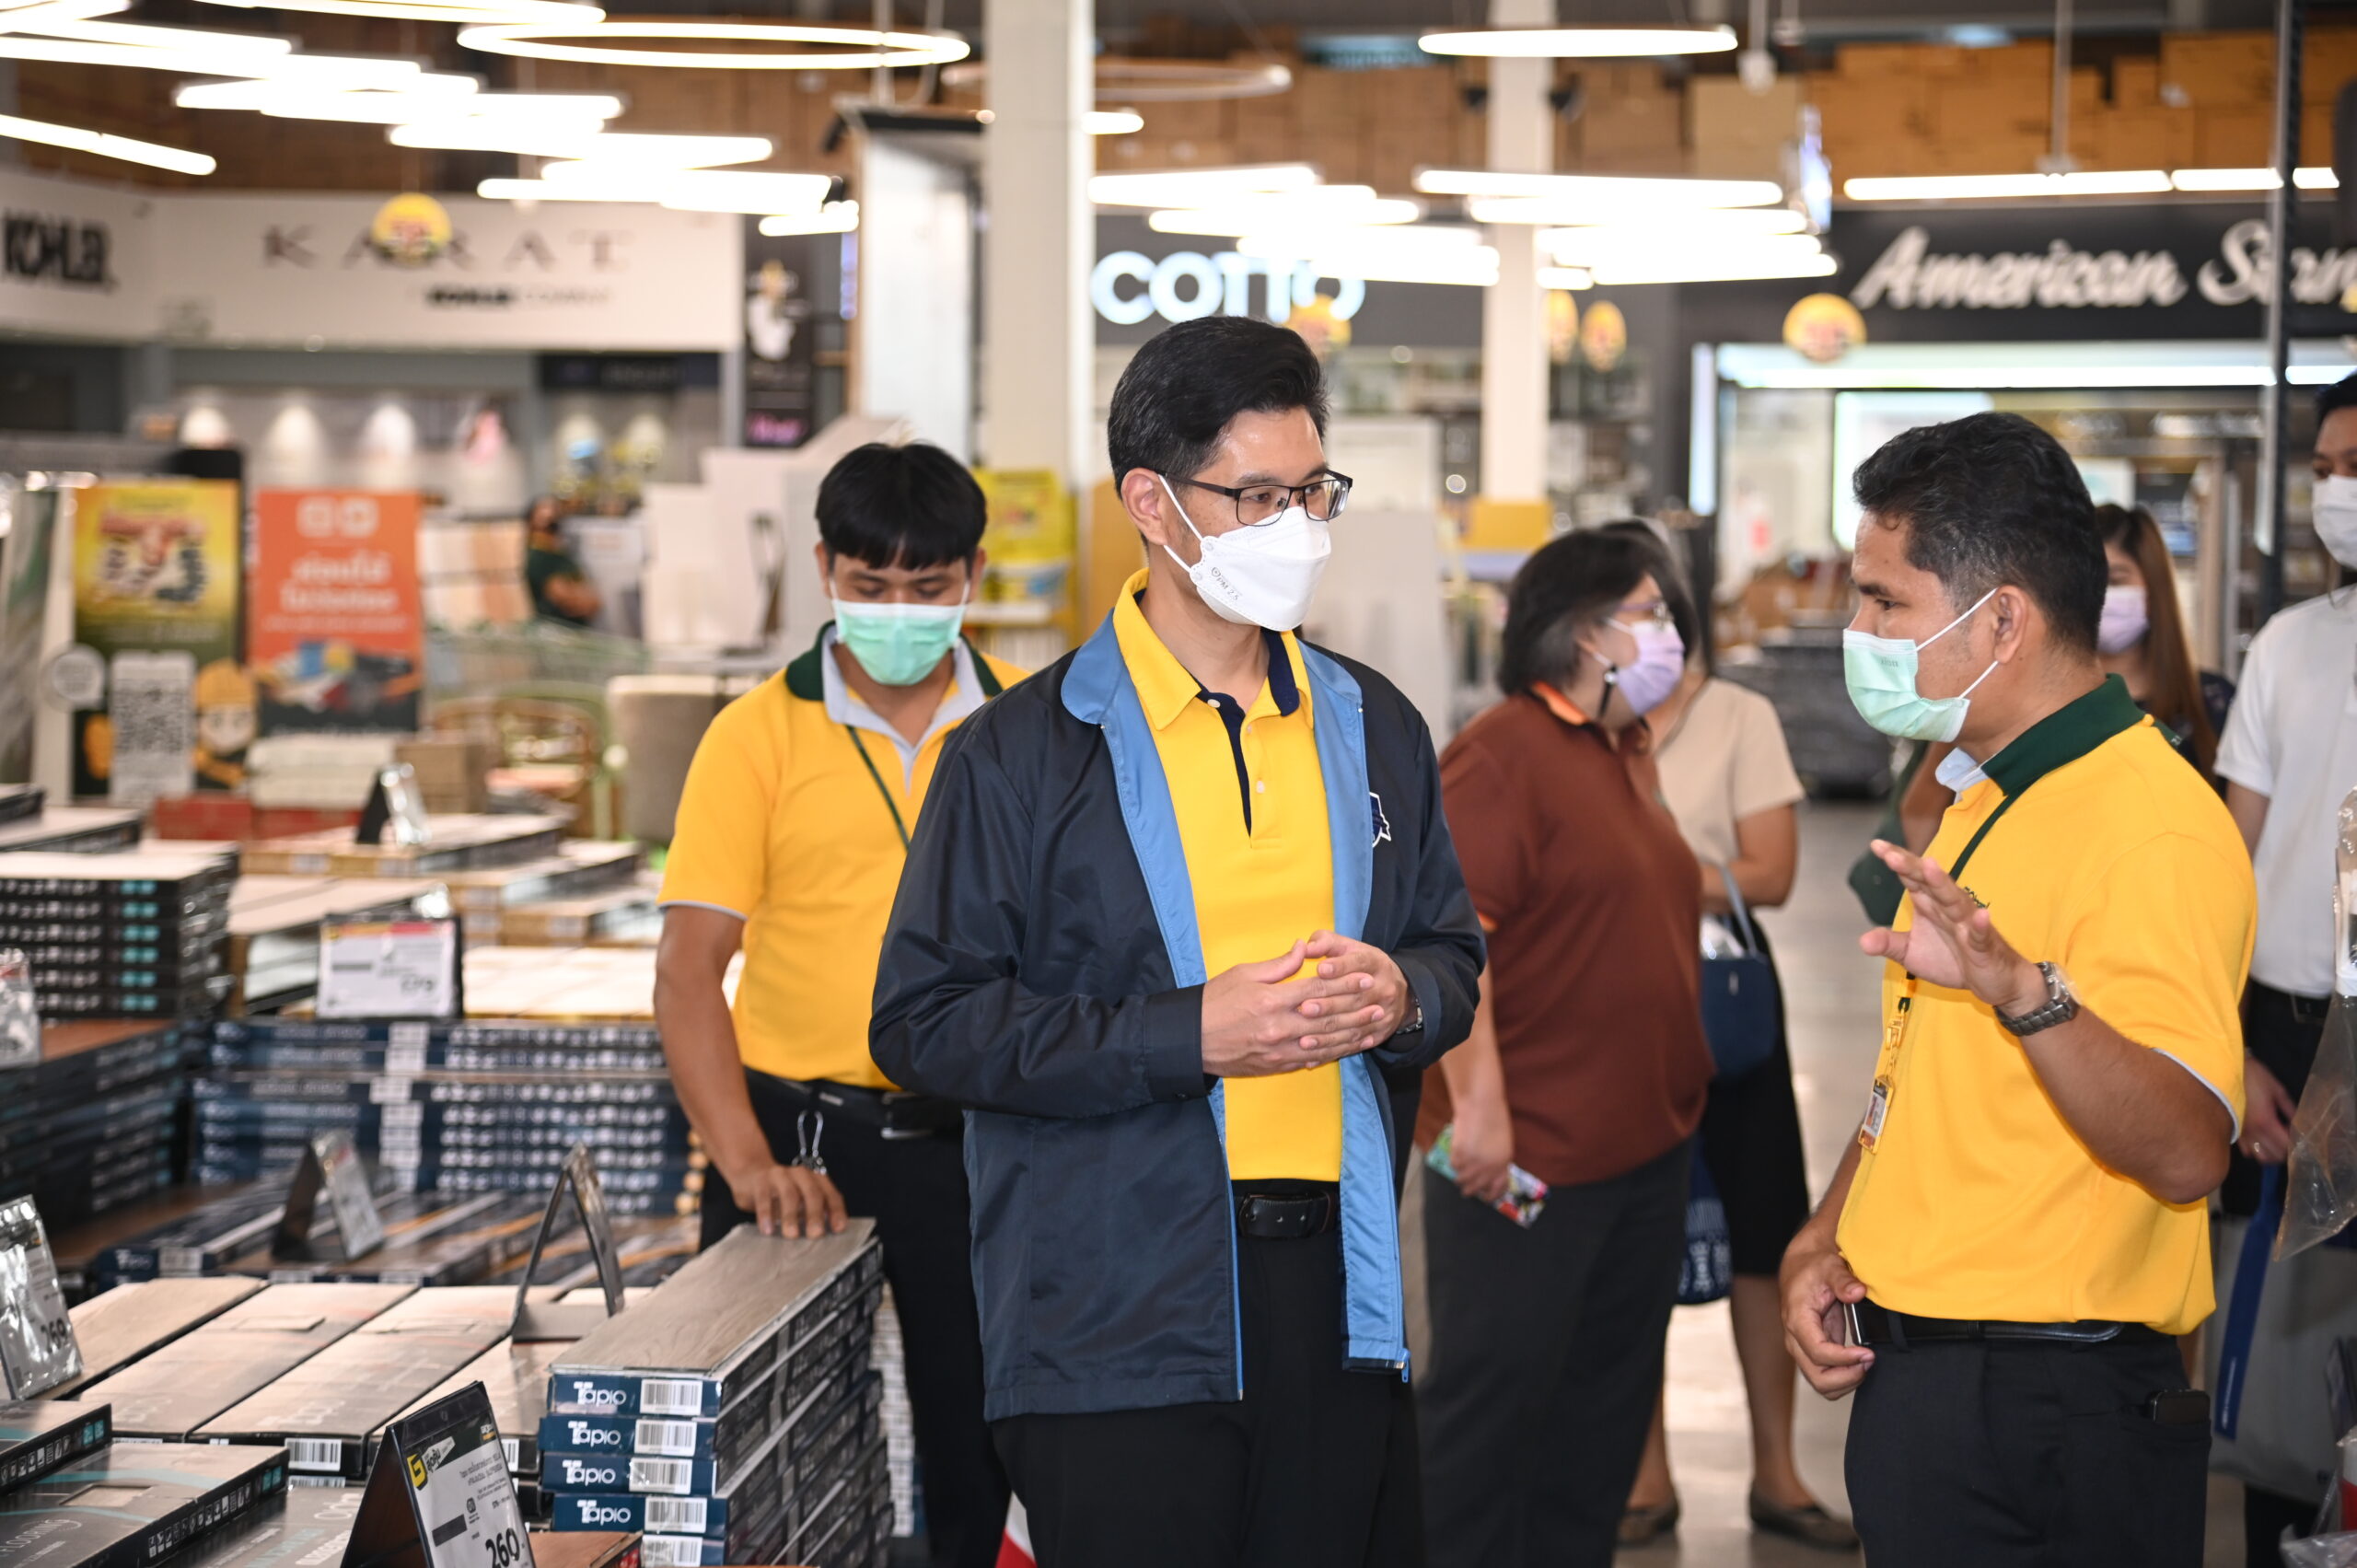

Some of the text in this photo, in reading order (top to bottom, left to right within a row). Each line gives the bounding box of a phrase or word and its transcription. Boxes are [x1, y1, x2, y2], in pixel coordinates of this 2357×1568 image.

[1847, 226, 2189, 309] American
[574, 1381, 626, 1408] Tapio
[568, 1421, 621, 1446] Tapio
[562, 1459, 616, 1486] Tapio
[577, 1499, 632, 1526] Tapio
